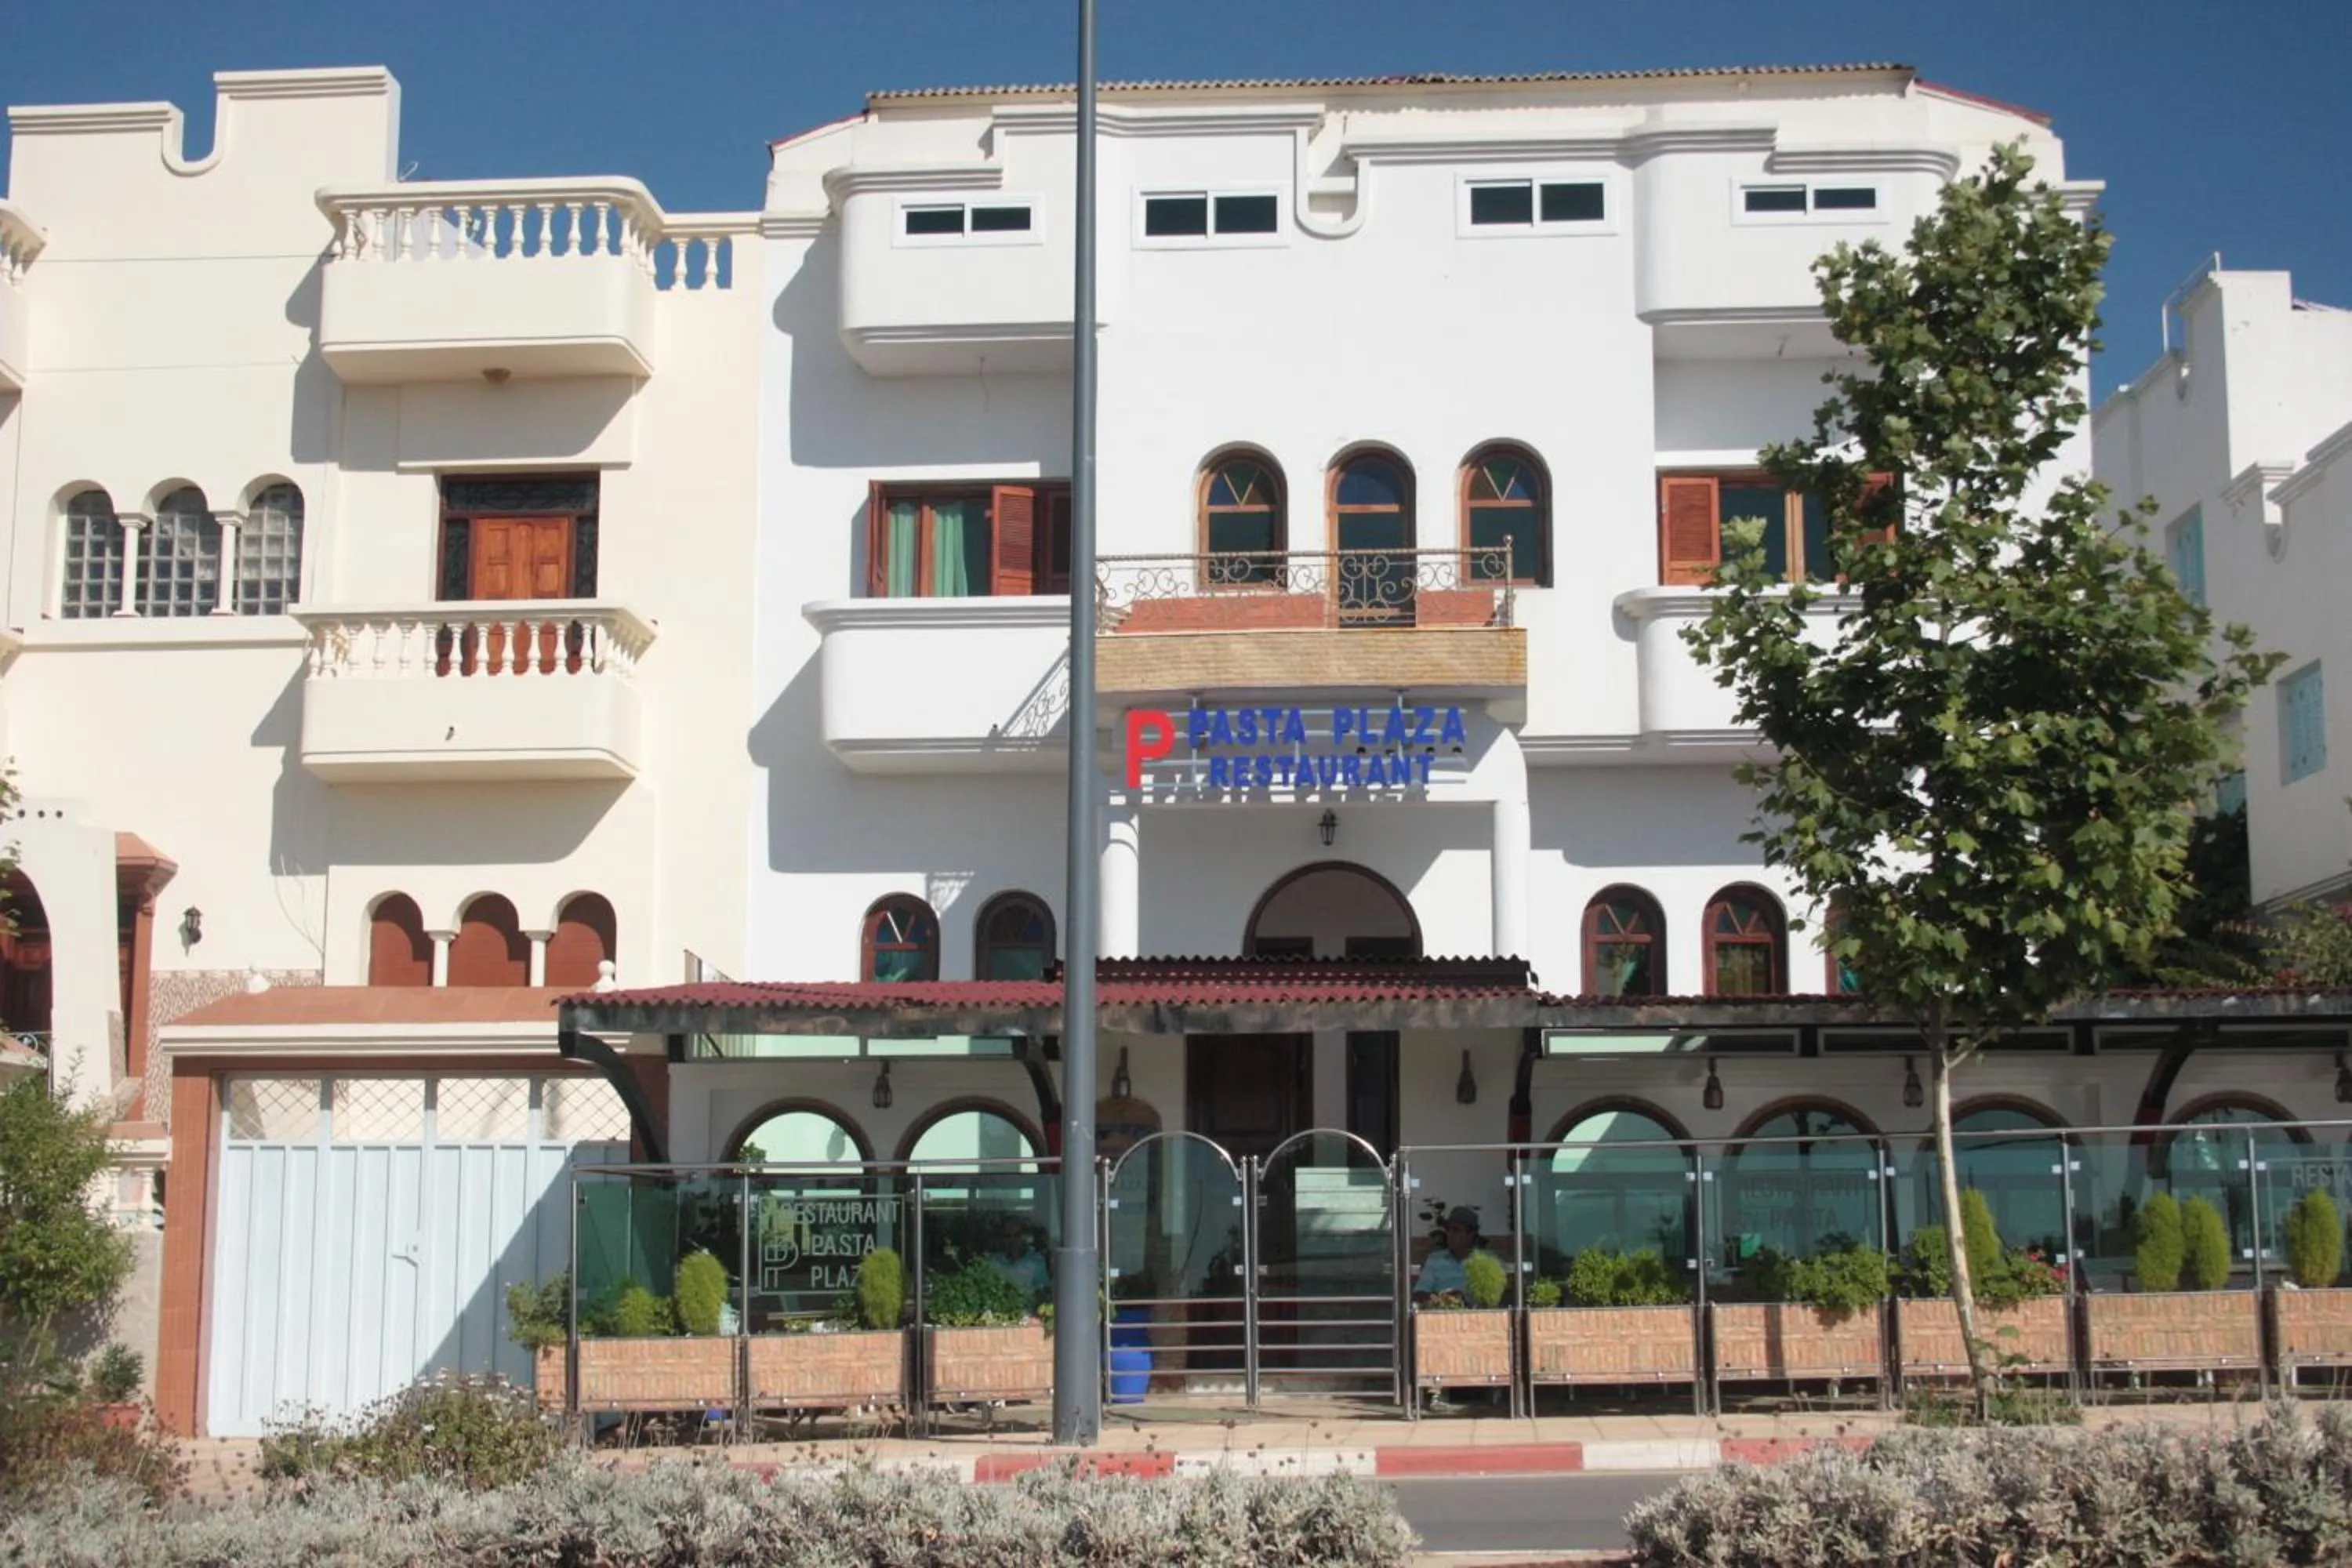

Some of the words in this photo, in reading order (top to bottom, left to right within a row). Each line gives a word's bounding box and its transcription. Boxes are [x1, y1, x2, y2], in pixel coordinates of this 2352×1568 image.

[1189, 708, 1305, 745] PASTA
[1334, 706, 1465, 744] PLAZA
[1126, 709, 1174, 788] P
[1210, 753, 1434, 787] RESTAURANT
[811, 1234, 876, 1256] PASTA
[811, 1265, 865, 1288] PLAZ
